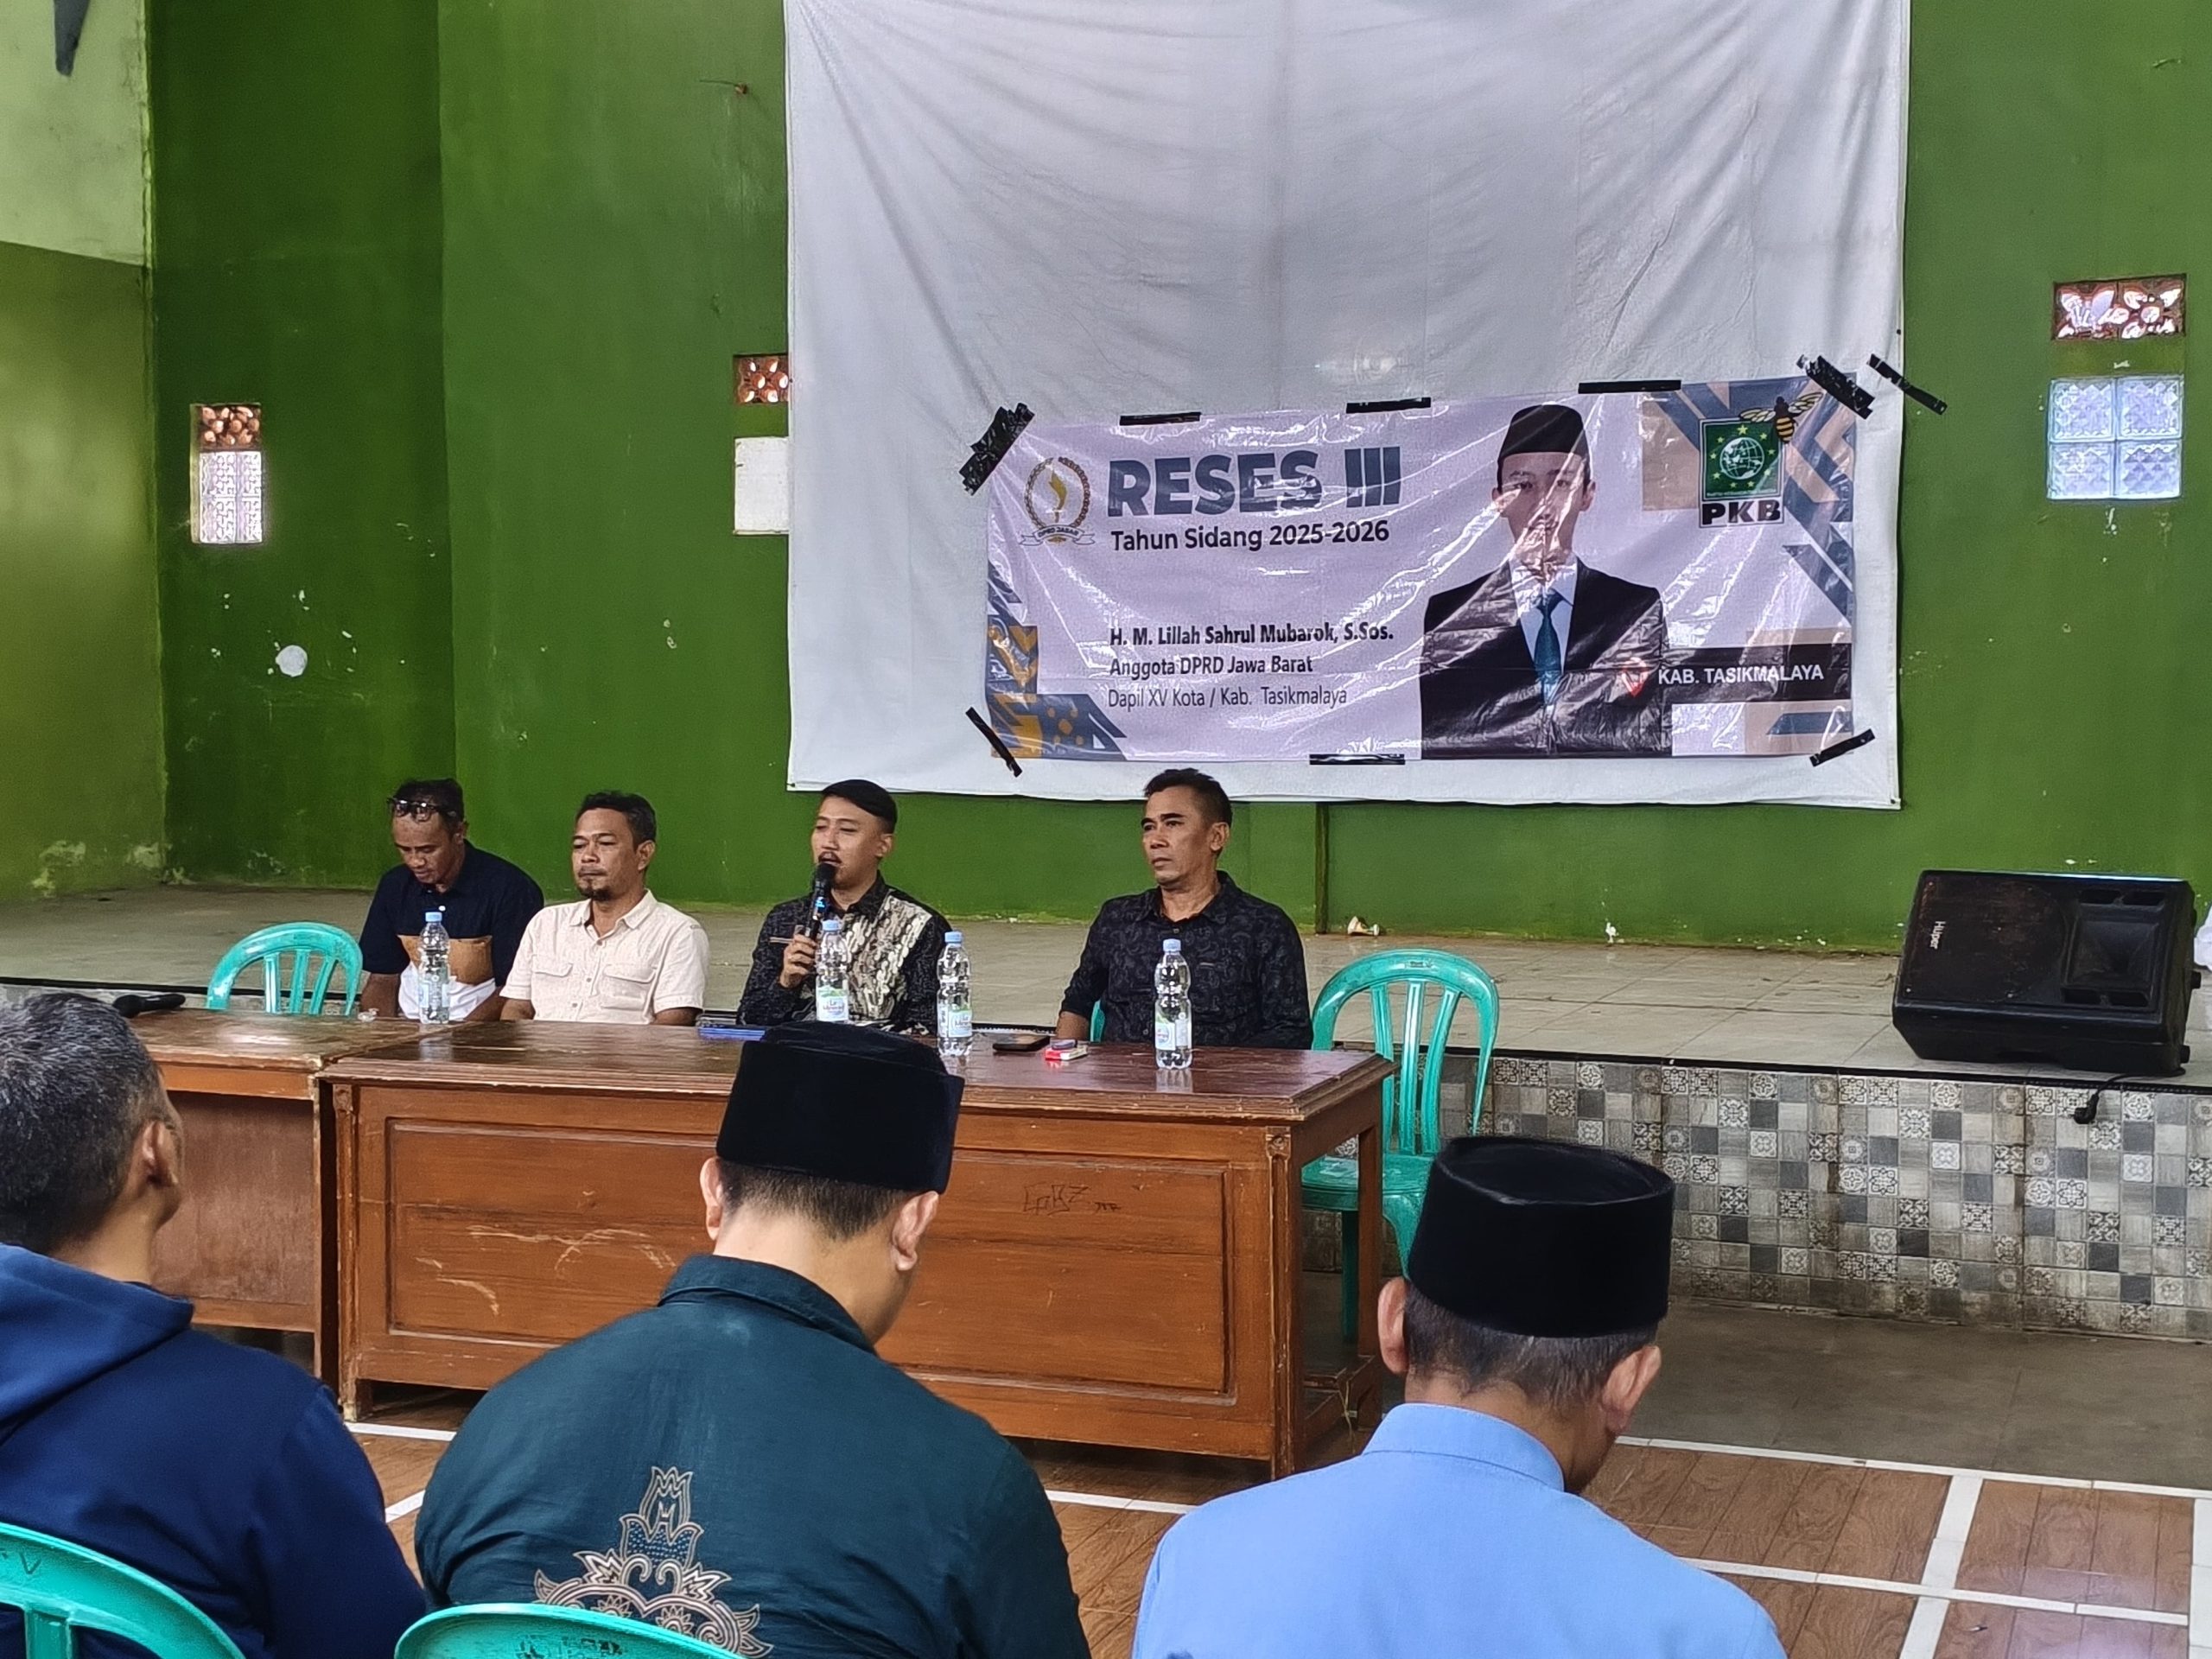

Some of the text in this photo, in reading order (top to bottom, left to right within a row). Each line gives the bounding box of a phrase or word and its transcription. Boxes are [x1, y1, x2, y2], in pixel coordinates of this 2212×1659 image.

[1108, 447, 1401, 517] RESES III
[1701, 499, 1781, 525] PKB
[1111, 519, 1389, 551] Tahun Sidang 2025-2026
[1109, 621, 1394, 645] H. M. Lillah Sahrul Mubarok, S.Sos.
[1109, 655, 1313, 681] Anggota DPRD Jawa Barat
[1658, 664, 1824, 685] KAB. TASIKMALAYA
[1109, 685, 1347, 712] Dapil XV Kota / Kab. Tasikmalaya
